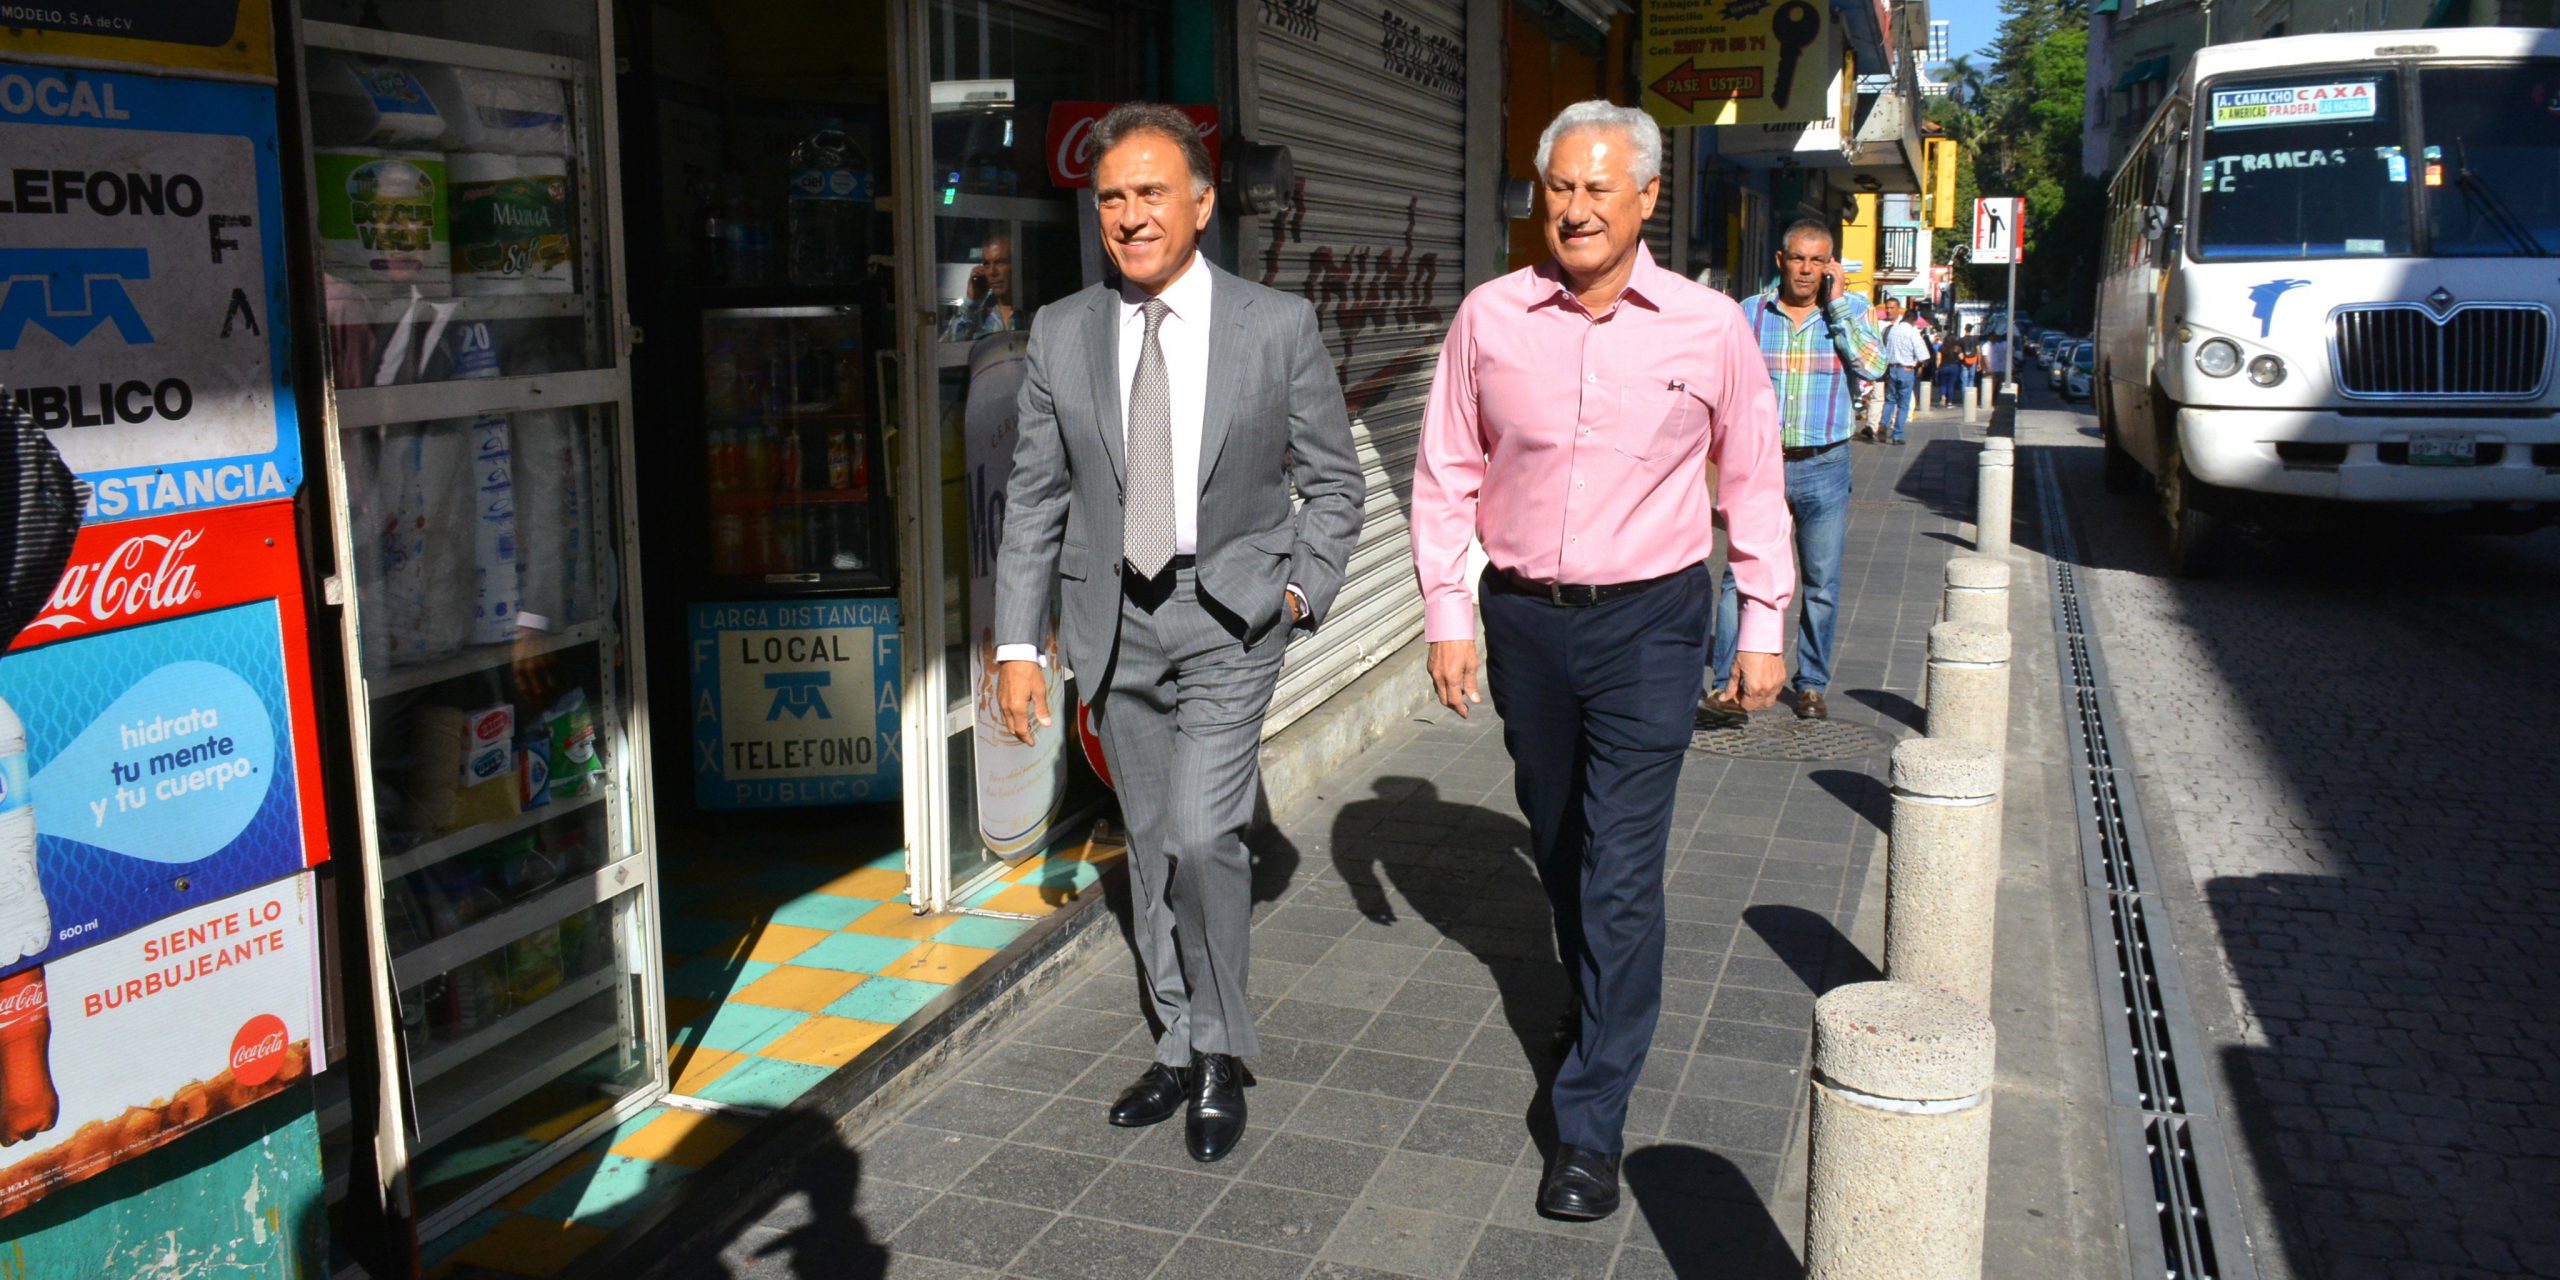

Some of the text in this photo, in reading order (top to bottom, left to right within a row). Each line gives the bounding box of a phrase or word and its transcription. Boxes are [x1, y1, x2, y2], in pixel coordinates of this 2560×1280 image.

[2, 4, 66, 25] MODELO,
[1649, 13, 1704, 23] Domicilio
[1649, 25, 1726, 37] Garantizados
[0, 74, 130, 121] OCAL
[1667, 76, 1754, 94] PASE USTED
[2234, 91, 2292, 106] CAMACHO
[2297, 85, 2368, 100] CAXA
[2228, 106, 2267, 119] AMERICAS
[2269, 103, 2317, 117] PRADERA
[2216, 149, 2347, 175] TRANCAS
[0, 168, 204, 218] EFONO
[15, 376, 192, 431] BLICO
[84, 461, 286, 517] ISTANCIA
[700, 603, 892, 630] LARGA DISTANCIA
[742, 635, 850, 664] LOCAL
[120, 707, 218, 751] hidrata
[111, 735, 234, 786] tu mente
[730, 736, 873, 771] TELEFONO
[89, 757, 259, 829] y tu cuerpo.
[59, 918, 99, 941] 600 ml
[144, 900, 282, 962] SIENTE LO
[84, 929, 285, 1018] BURBUJEANTE
[0, 981, 43, 1012] ca-Cola
[232, 1030, 284, 1068] Coca-Cola
